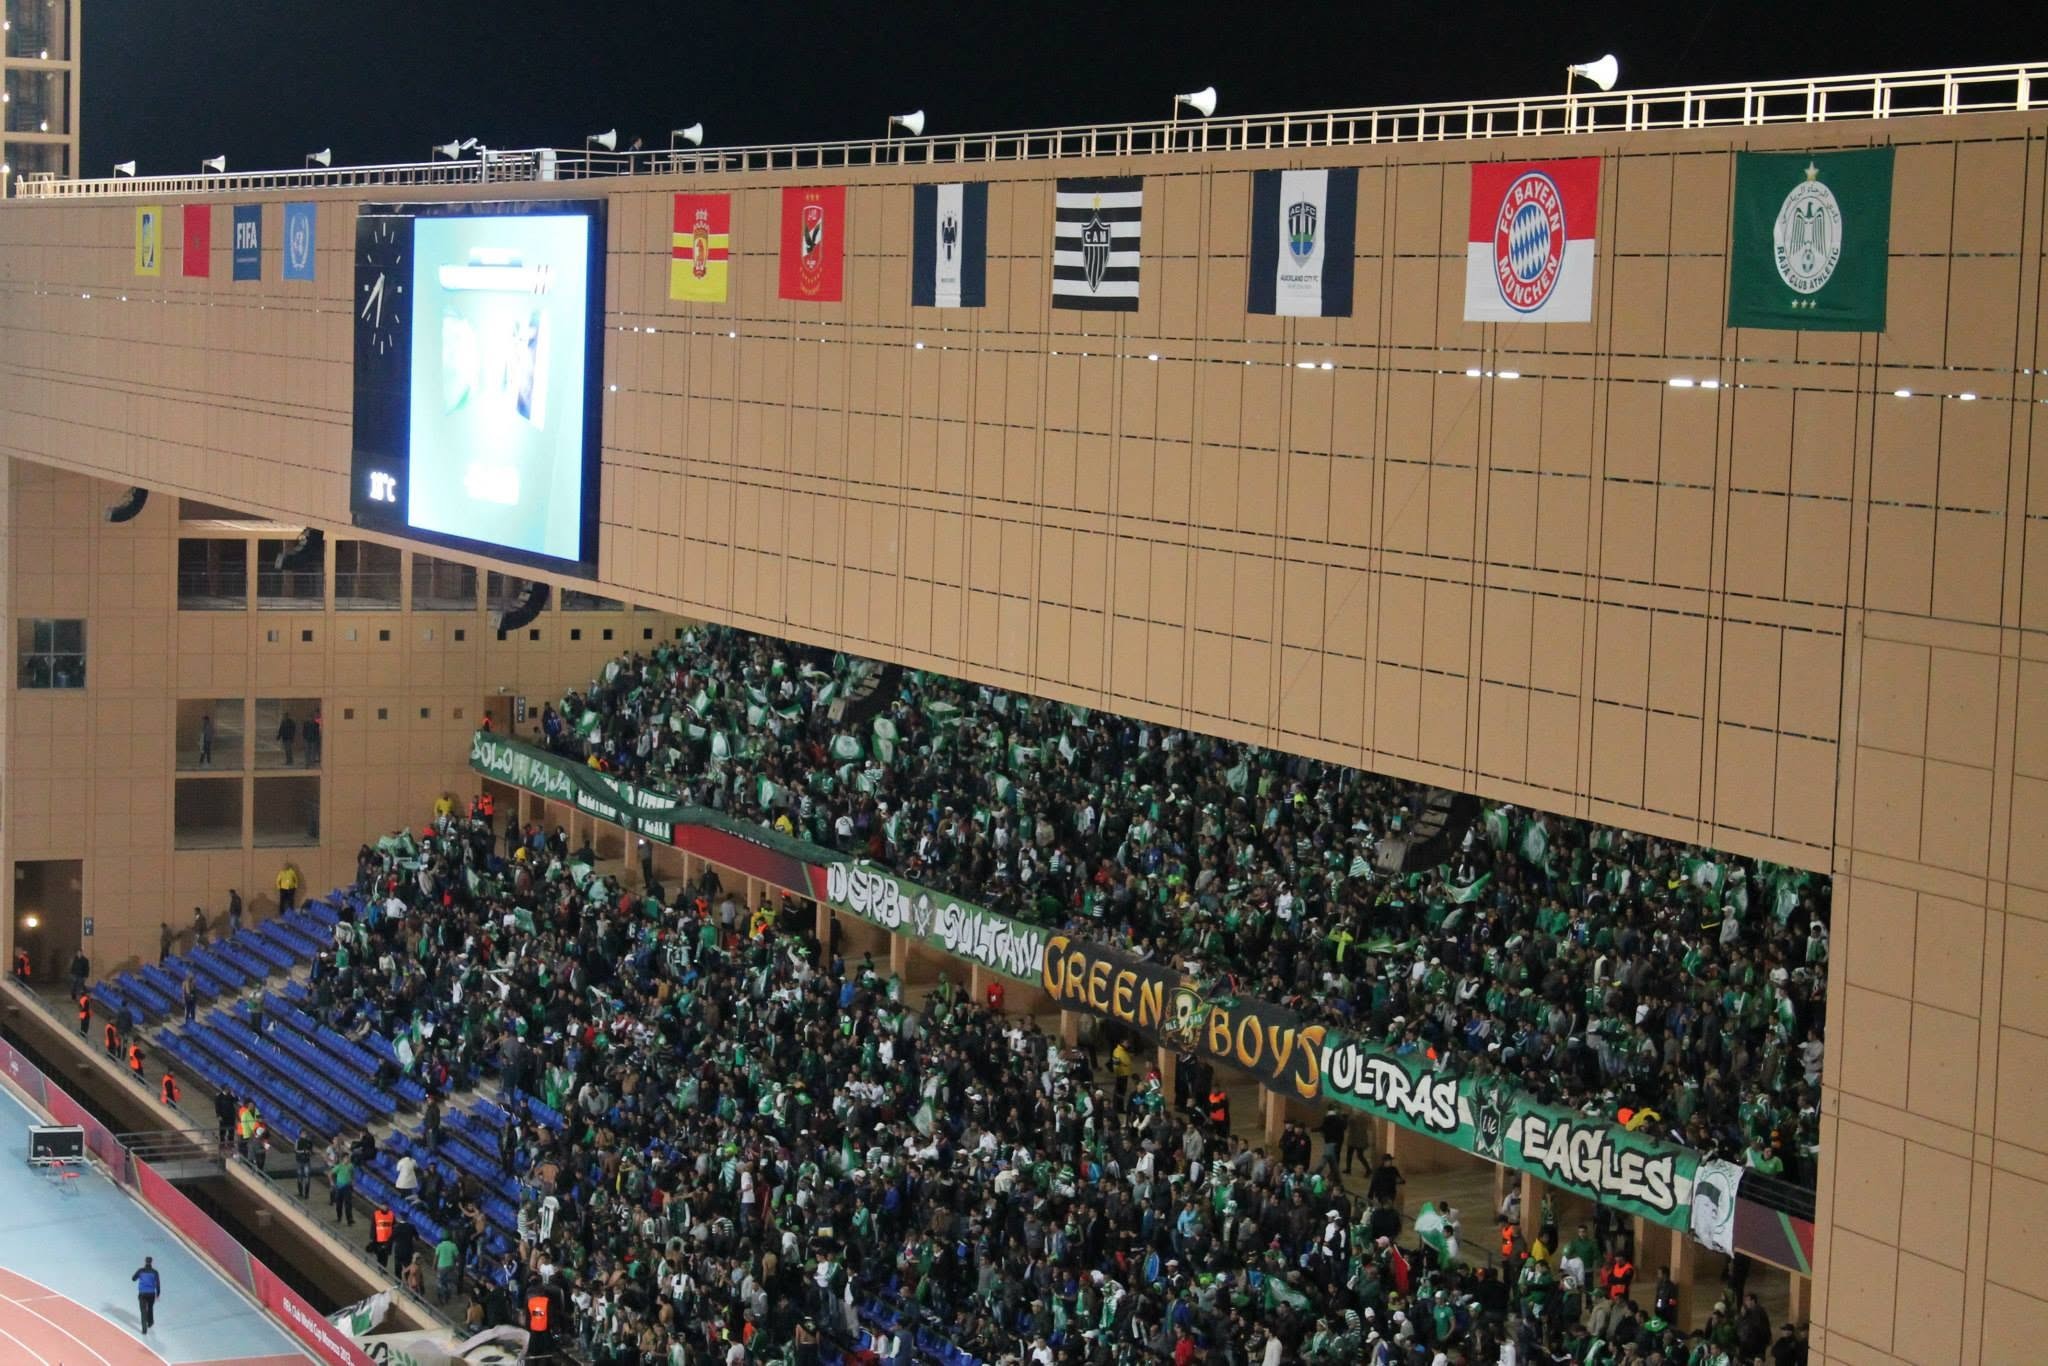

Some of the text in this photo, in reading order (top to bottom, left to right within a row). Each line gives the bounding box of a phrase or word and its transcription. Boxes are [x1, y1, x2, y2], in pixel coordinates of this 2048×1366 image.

[236, 221, 257, 249] FIFA
[1084, 230, 1107, 243] CAM
[1500, 181, 1561, 235] FC BAYERN
[1777, 246, 1839, 291] RAJA CLUB ATHLETIC
[471, 731, 572, 801] SOLO RAJA
[828, 861, 901, 928] DERB
[1042, 936, 1328, 1099] GREEN BOYS
[1331, 1043, 1675, 1211] ULTRAS EAGLES
